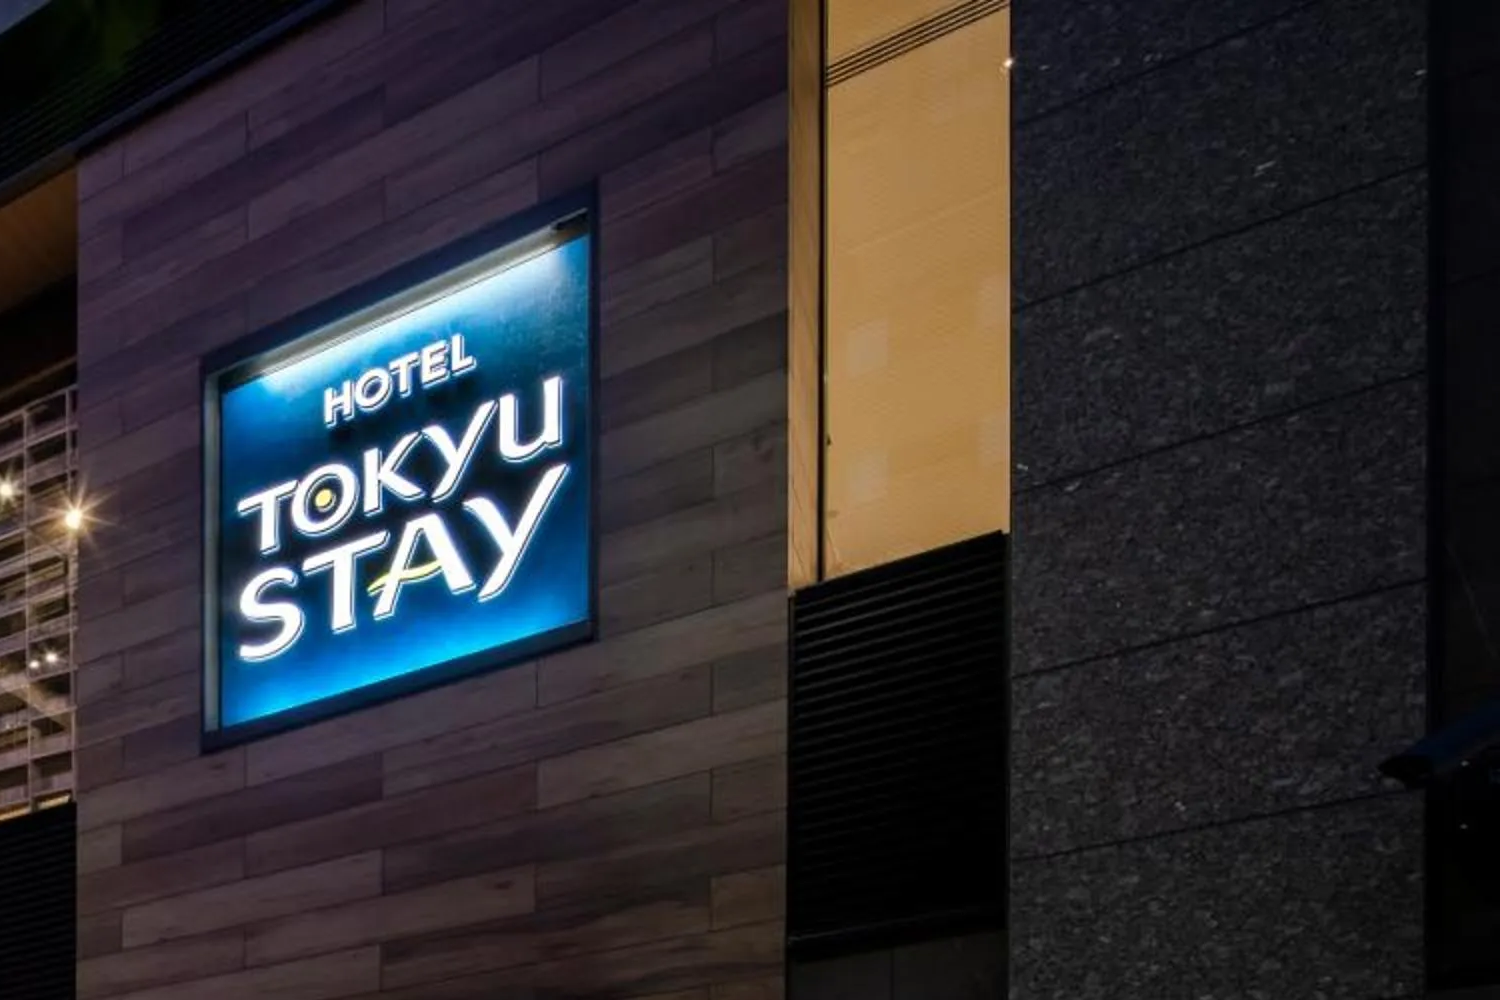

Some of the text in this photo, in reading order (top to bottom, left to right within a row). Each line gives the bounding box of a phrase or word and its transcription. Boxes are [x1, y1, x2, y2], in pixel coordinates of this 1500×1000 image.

[237, 376, 564, 555] TOKYU
[323, 333, 477, 427] HOTEL
[238, 463, 570, 663] STAY
